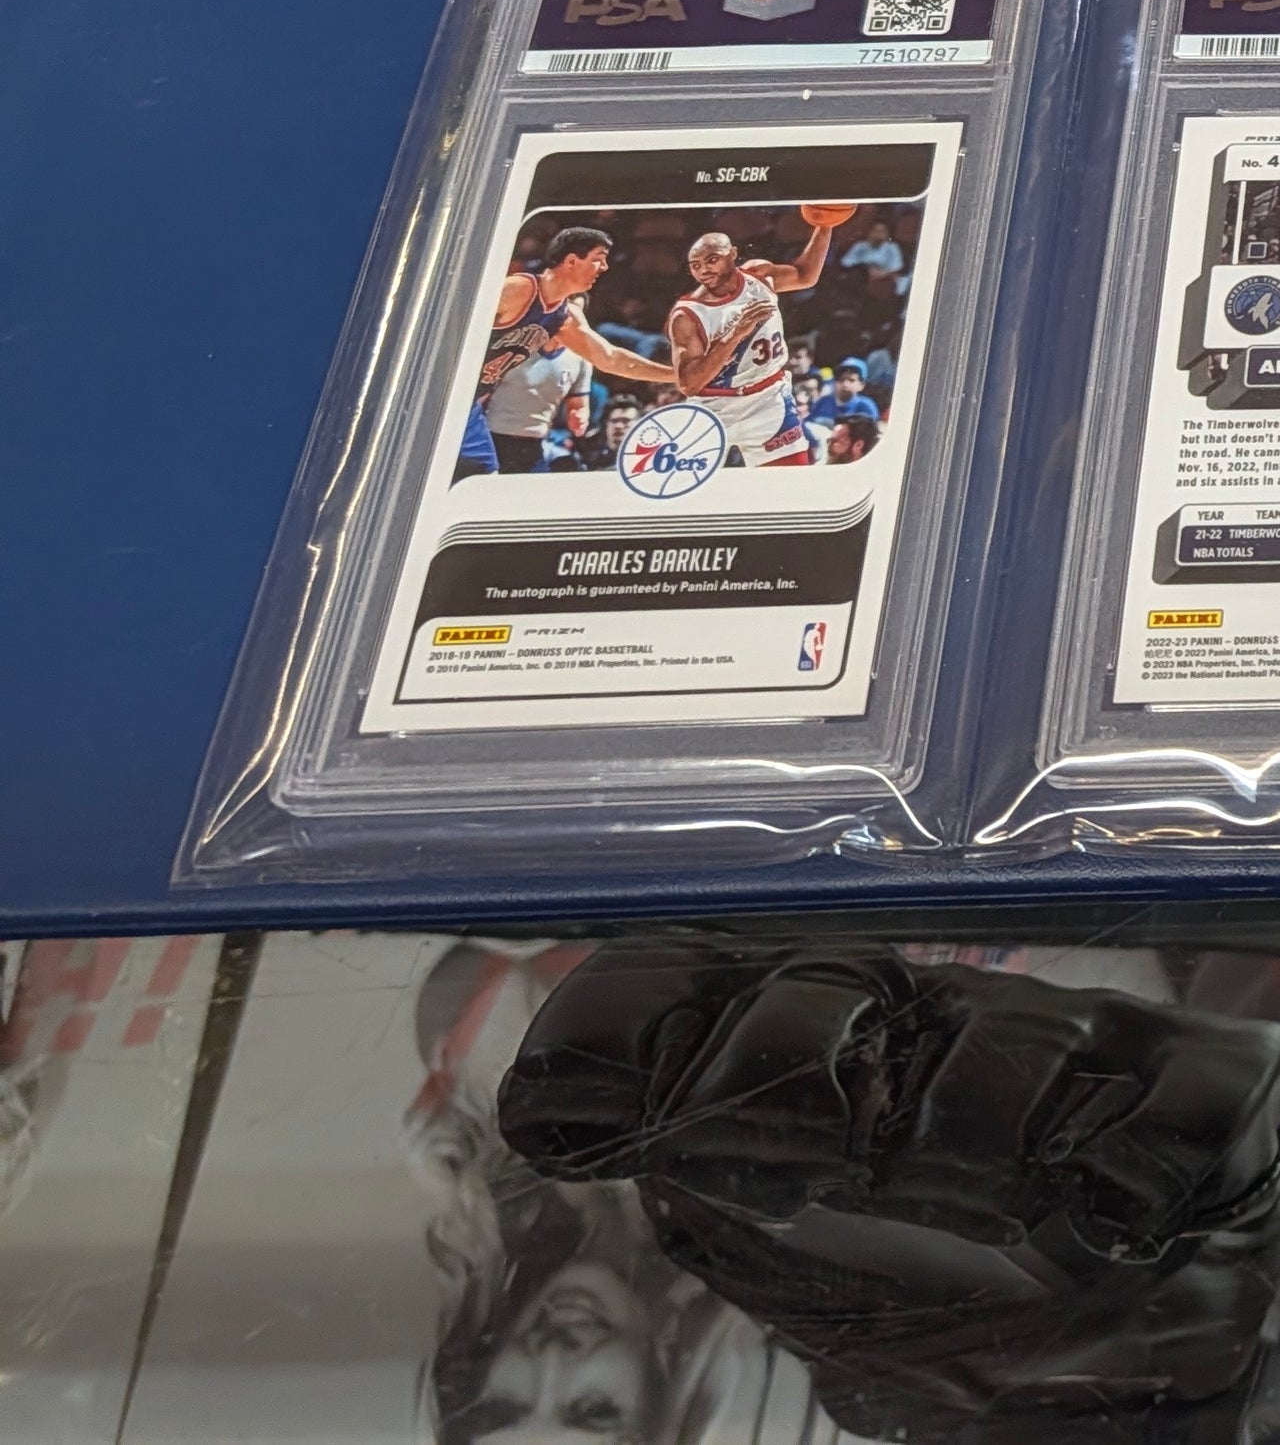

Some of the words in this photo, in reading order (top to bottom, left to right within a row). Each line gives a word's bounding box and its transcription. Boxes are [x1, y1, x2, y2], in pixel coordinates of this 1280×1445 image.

[859, 47, 960, 65] 77510797
[1241, 158, 1263, 169] No.
[696, 171, 713, 183] No.
[717, 166, 770, 183] SG-CBK
[751, 332, 784, 366] 32
[1183, 420, 1203, 431] The
[632, 443, 708, 474] 76ers
[1197, 510, 1224, 521] YEAR
[1195, 529, 1222, 539] 21-22
[1193, 548, 1214, 559] NBA
[1215, 547, 1254, 558] TOTALS
[557, 550, 646, 577] CHARLES
[649, 547, 738, 574] BARKLEY
[485, 587, 508, 599] The
[509, 585, 574, 601] autograph
[577, 585, 587, 597] is
[590, 583, 660, 598] guaranteed
[662, 582, 678, 596] by
[680, 579, 718, 593] Panini
[721, 579, 774, 593] America,
[777, 578, 799, 590] Inc.
[1153, 613, 1218, 625] PANINI
[439, 629, 506, 642] PANINI
[524, 627, 585, 635] PRIZM
[1146, 637, 1188, 648] 2022-23
[1190, 636, 1223, 646] PANINI
[1233, 635, 1279, 645] DONRUSS
[429, 650, 471, 661] 2018-19
[473, 649, 506, 659] PANINI
[517, 648, 562, 658] DONRUSS
[564, 646, 593, 656] OPTIC
[595, 644, 654, 655] BASKETBALL
